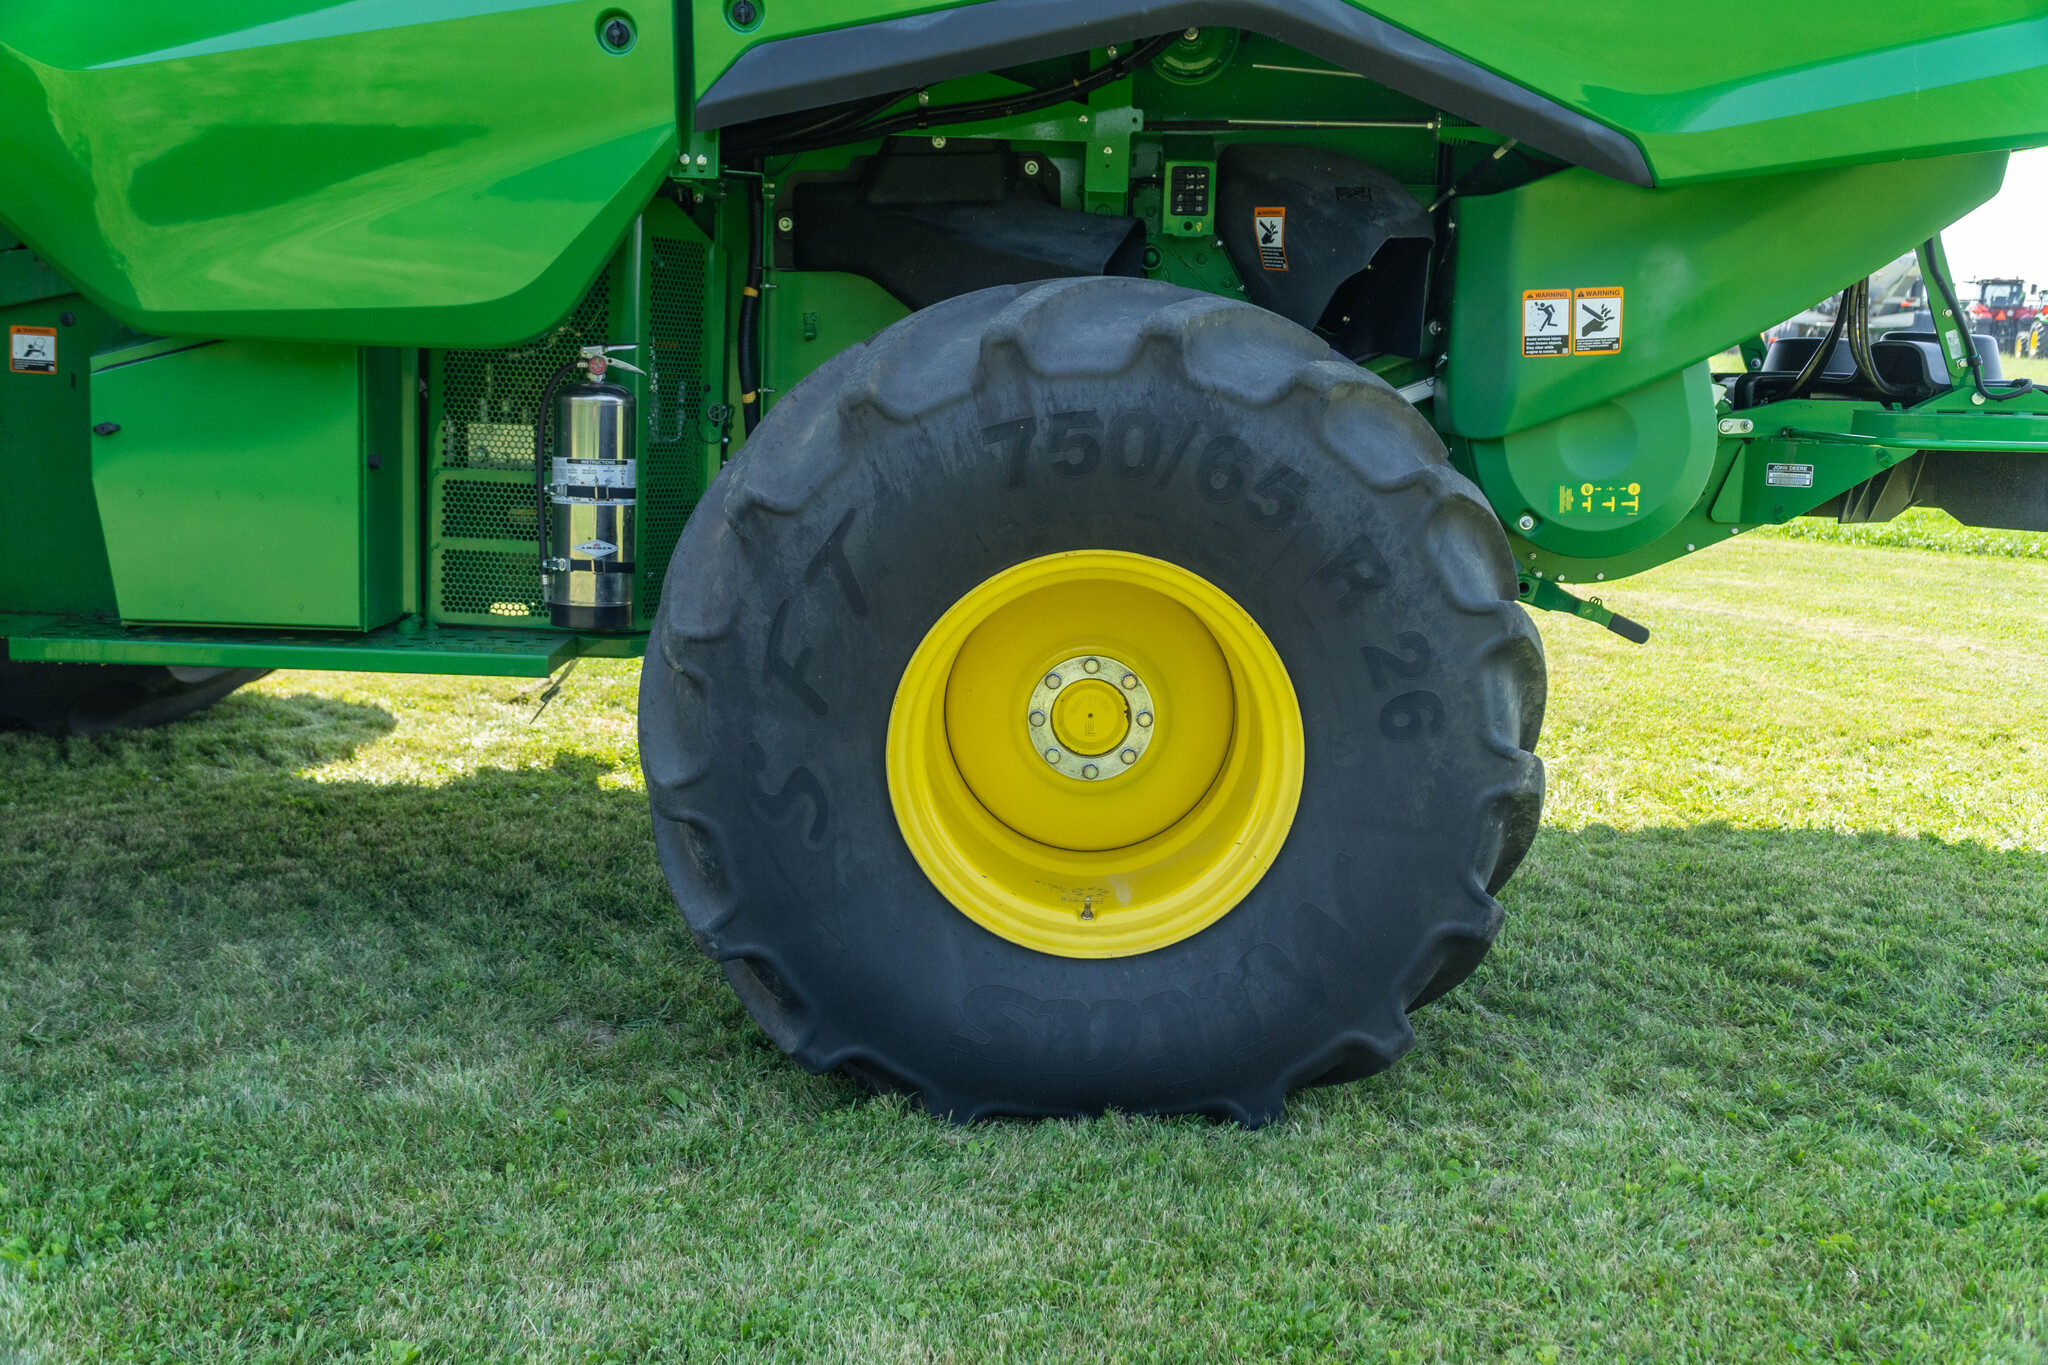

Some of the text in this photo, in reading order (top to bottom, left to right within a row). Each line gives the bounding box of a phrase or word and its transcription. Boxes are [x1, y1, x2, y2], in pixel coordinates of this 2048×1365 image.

[1585, 289, 1621, 297] WARNING
[979, 410, 1445, 744] 750/65 R 26
